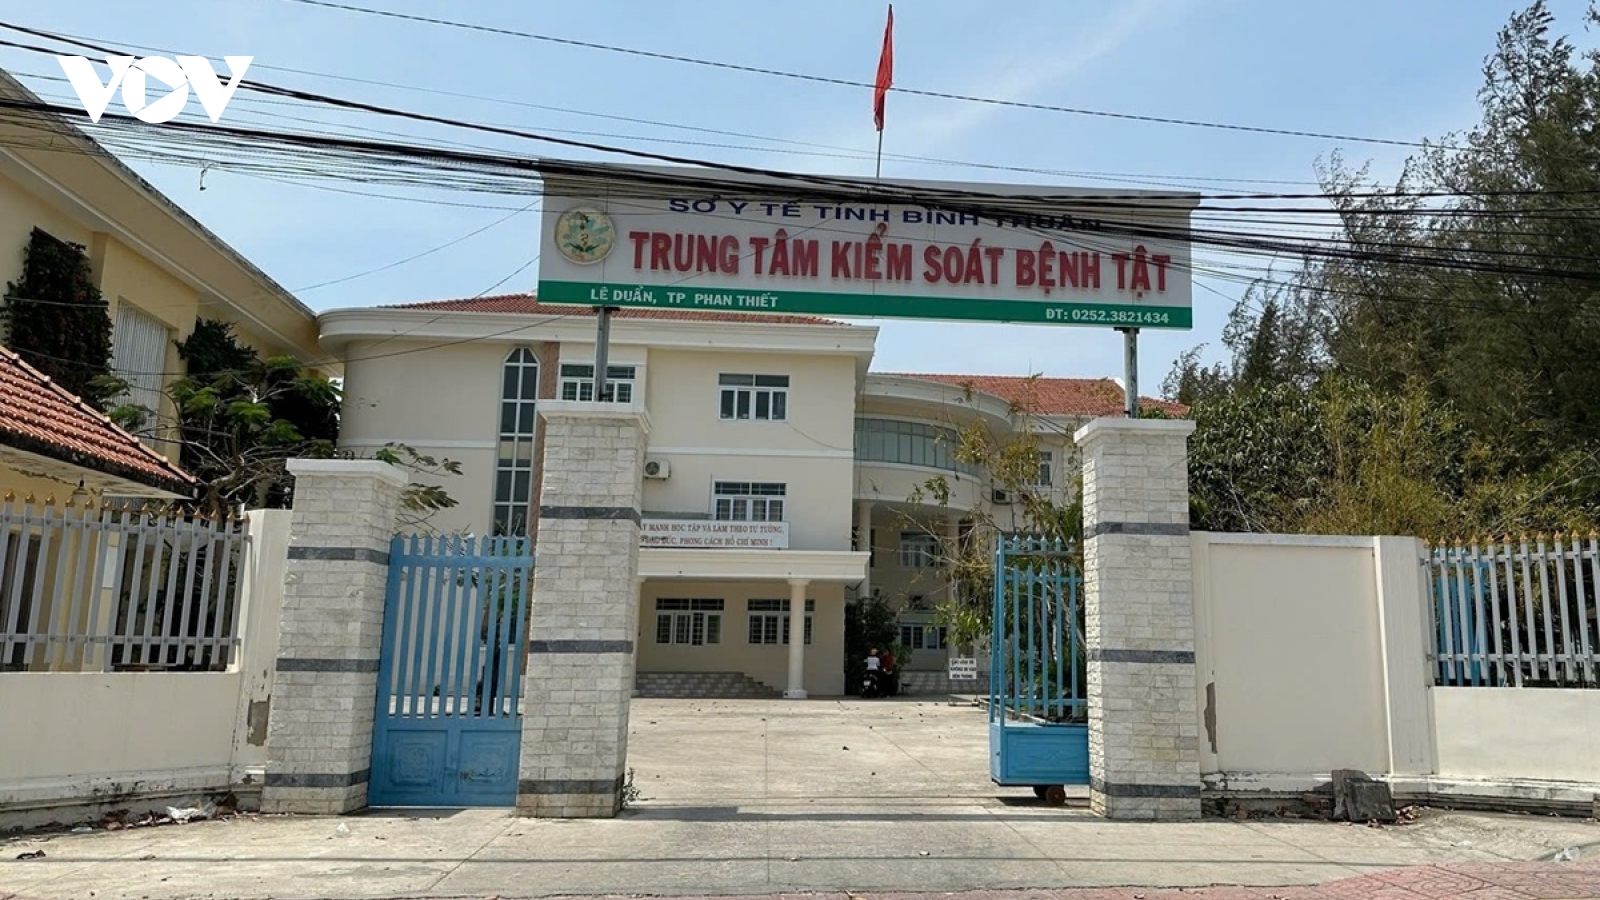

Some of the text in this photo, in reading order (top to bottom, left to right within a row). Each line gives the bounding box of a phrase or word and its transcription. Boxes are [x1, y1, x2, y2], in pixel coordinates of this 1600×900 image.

[729, 202, 748, 215] Y
[629, 222, 1170, 298] TRUNG TÂM KIỂM SOÁT BỆNH TẬT
[591, 287, 608, 300] LÊ
[667, 292, 685, 304] TP
[695, 294, 732, 306] PHAN
[736, 293, 778, 308] THIẾT
[1045, 308, 1170, 324] ĐT: 0252.3821434
